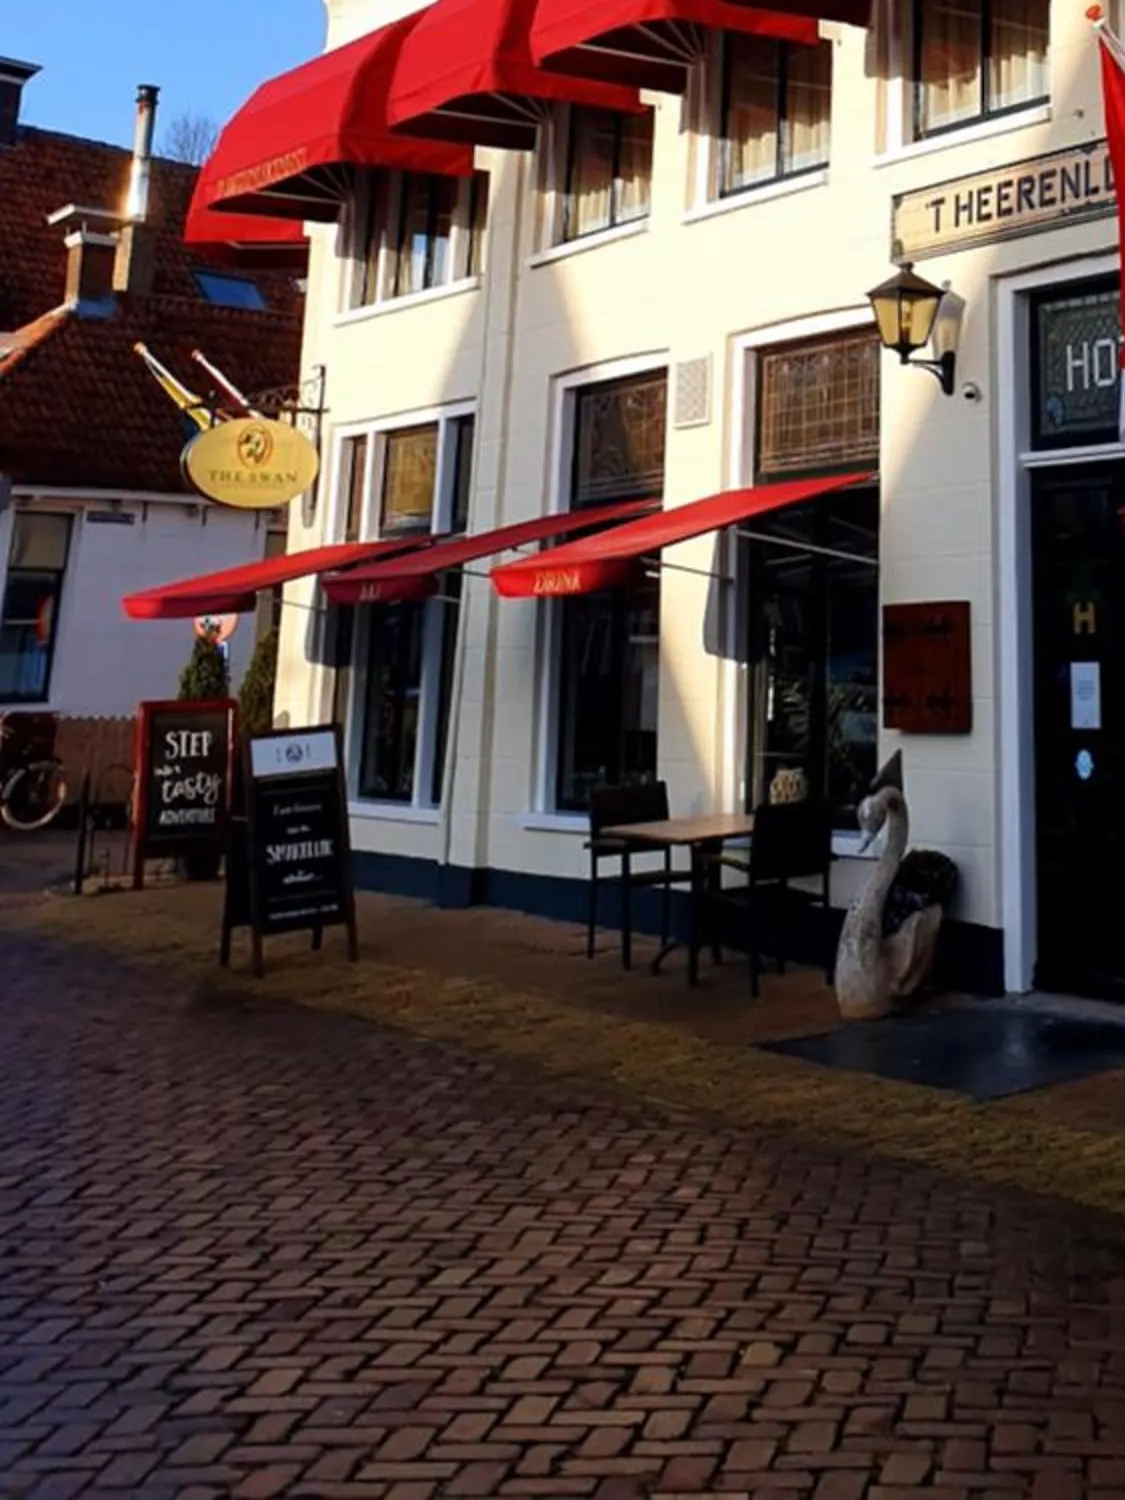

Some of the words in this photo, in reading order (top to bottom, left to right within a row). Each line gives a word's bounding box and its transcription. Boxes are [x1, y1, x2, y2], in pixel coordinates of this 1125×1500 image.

[209, 470, 241, 482] THE
[165, 730, 213, 759] STEP
[162, 771, 221, 804] tasty
